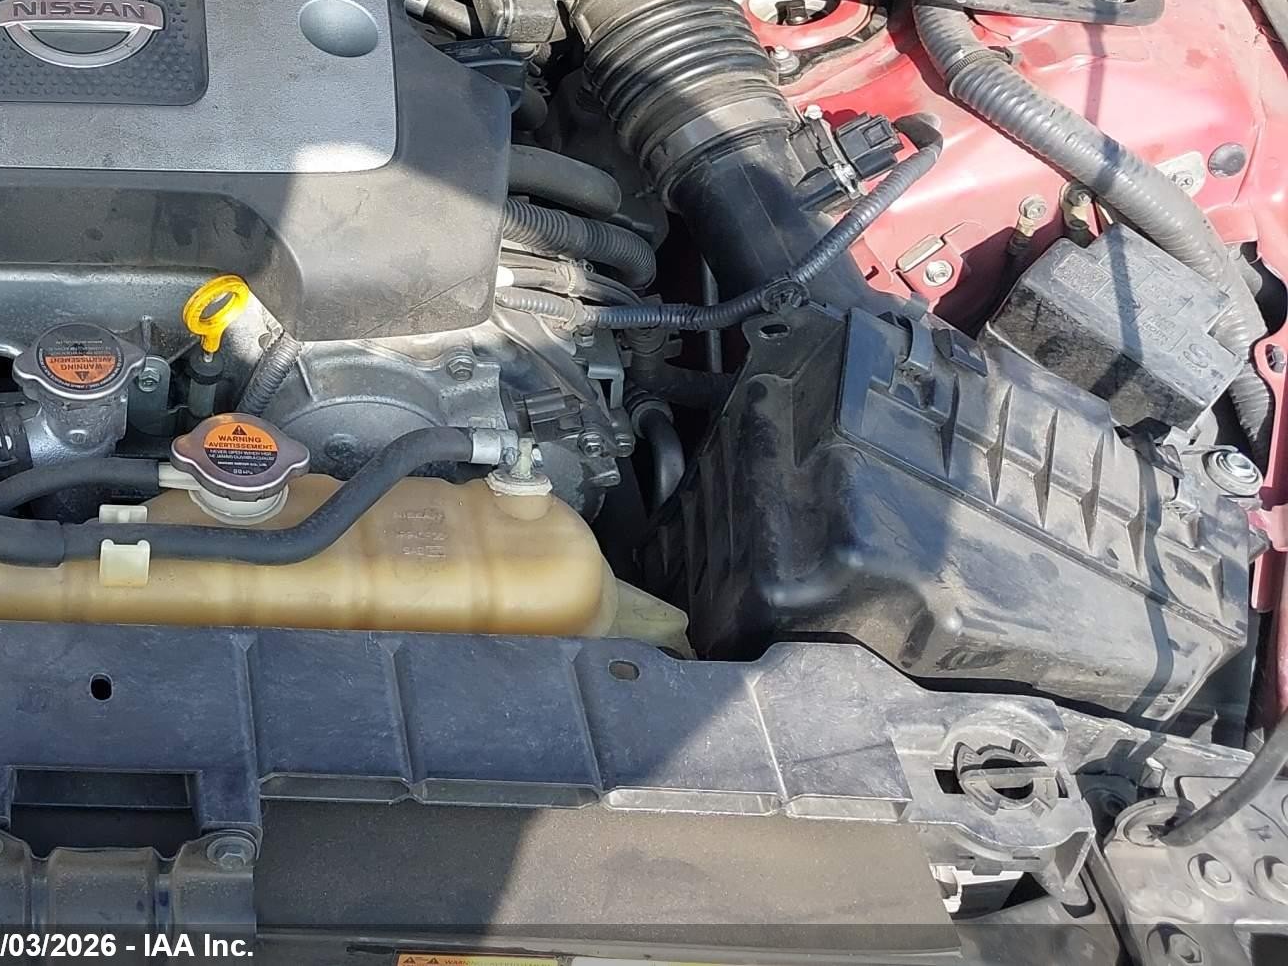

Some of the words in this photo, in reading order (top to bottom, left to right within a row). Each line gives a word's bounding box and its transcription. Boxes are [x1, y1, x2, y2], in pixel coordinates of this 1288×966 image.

[12, 0, 146, 20] NISSAN
[60, 363, 103, 371] WARNING
[217, 435, 262, 443] WARNING
[208, 442, 273, 450] AVERTISSEMENT
